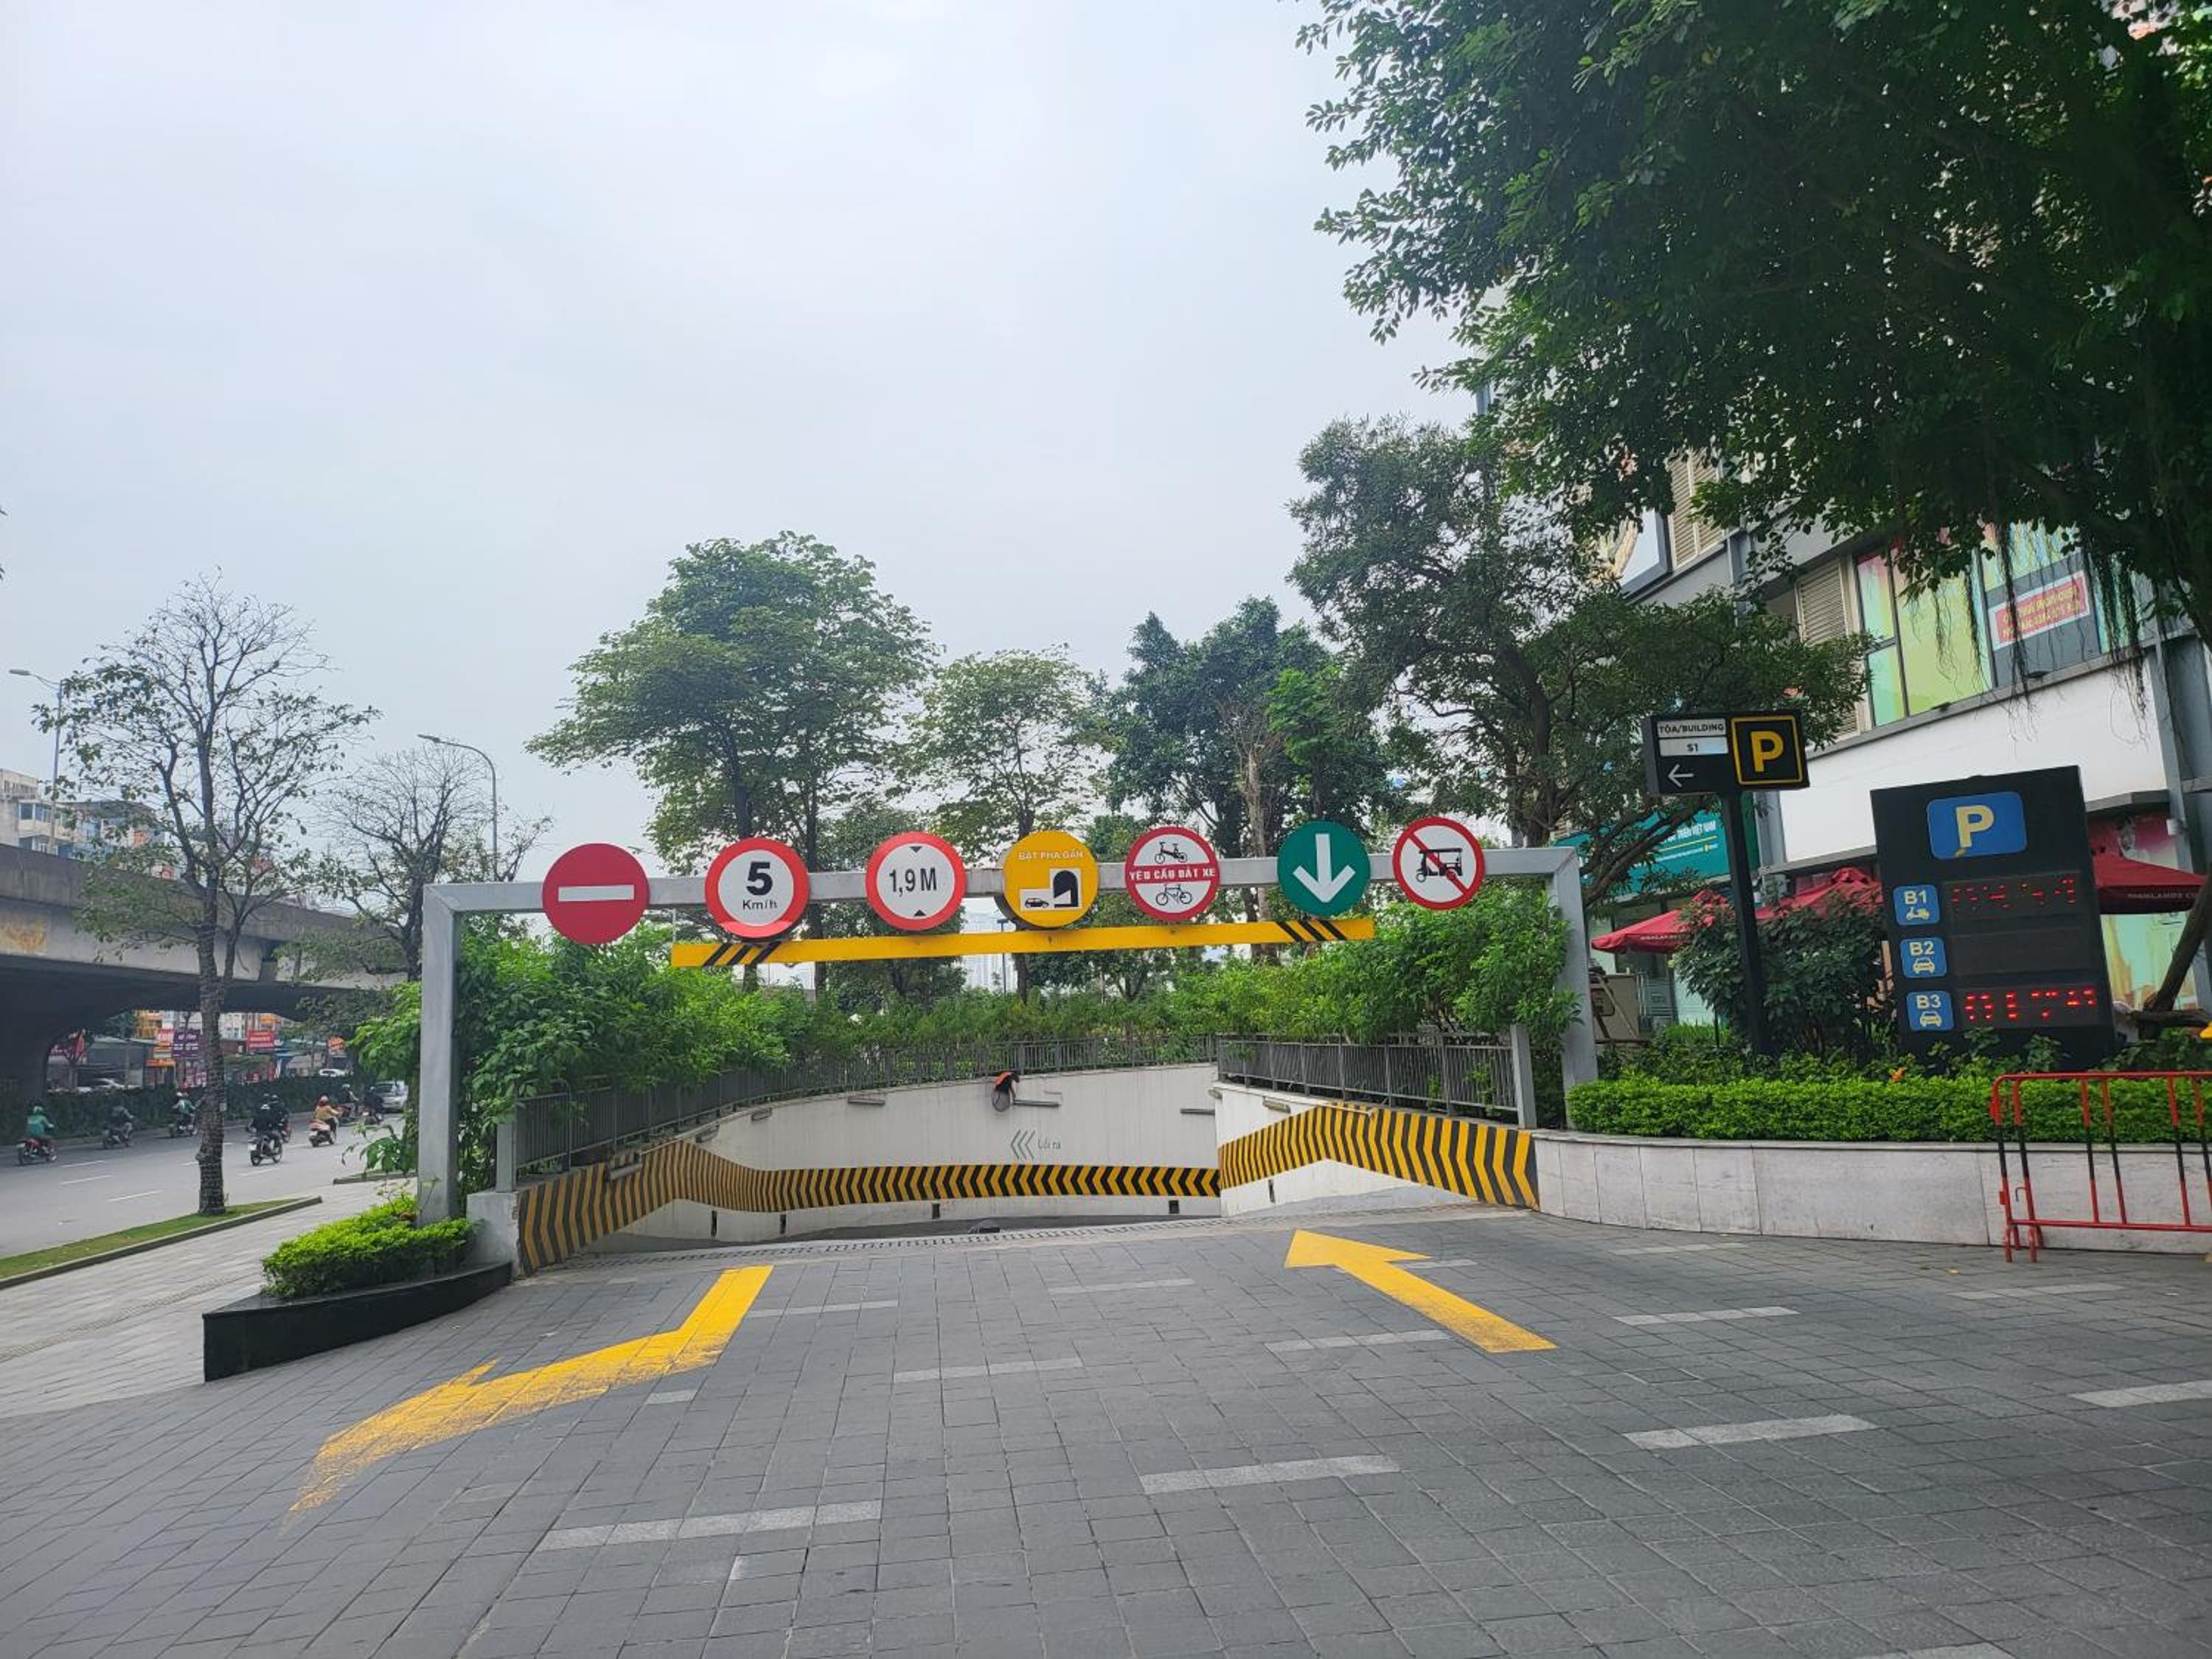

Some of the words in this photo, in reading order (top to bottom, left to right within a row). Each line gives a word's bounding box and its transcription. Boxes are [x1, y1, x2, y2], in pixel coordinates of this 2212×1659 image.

[1686, 742, 1699, 752] S1
[1750, 731, 1784, 772] P
[1955, 804, 1994, 849] P
[746, 861, 773, 896] 5
[1203, 867, 1216, 877] XE
[742, 899, 778, 911] Km/h
[1904, 889, 1927, 905] B1
[1909, 940, 1935, 956] B2
[1916, 994, 1941, 1009] B3
